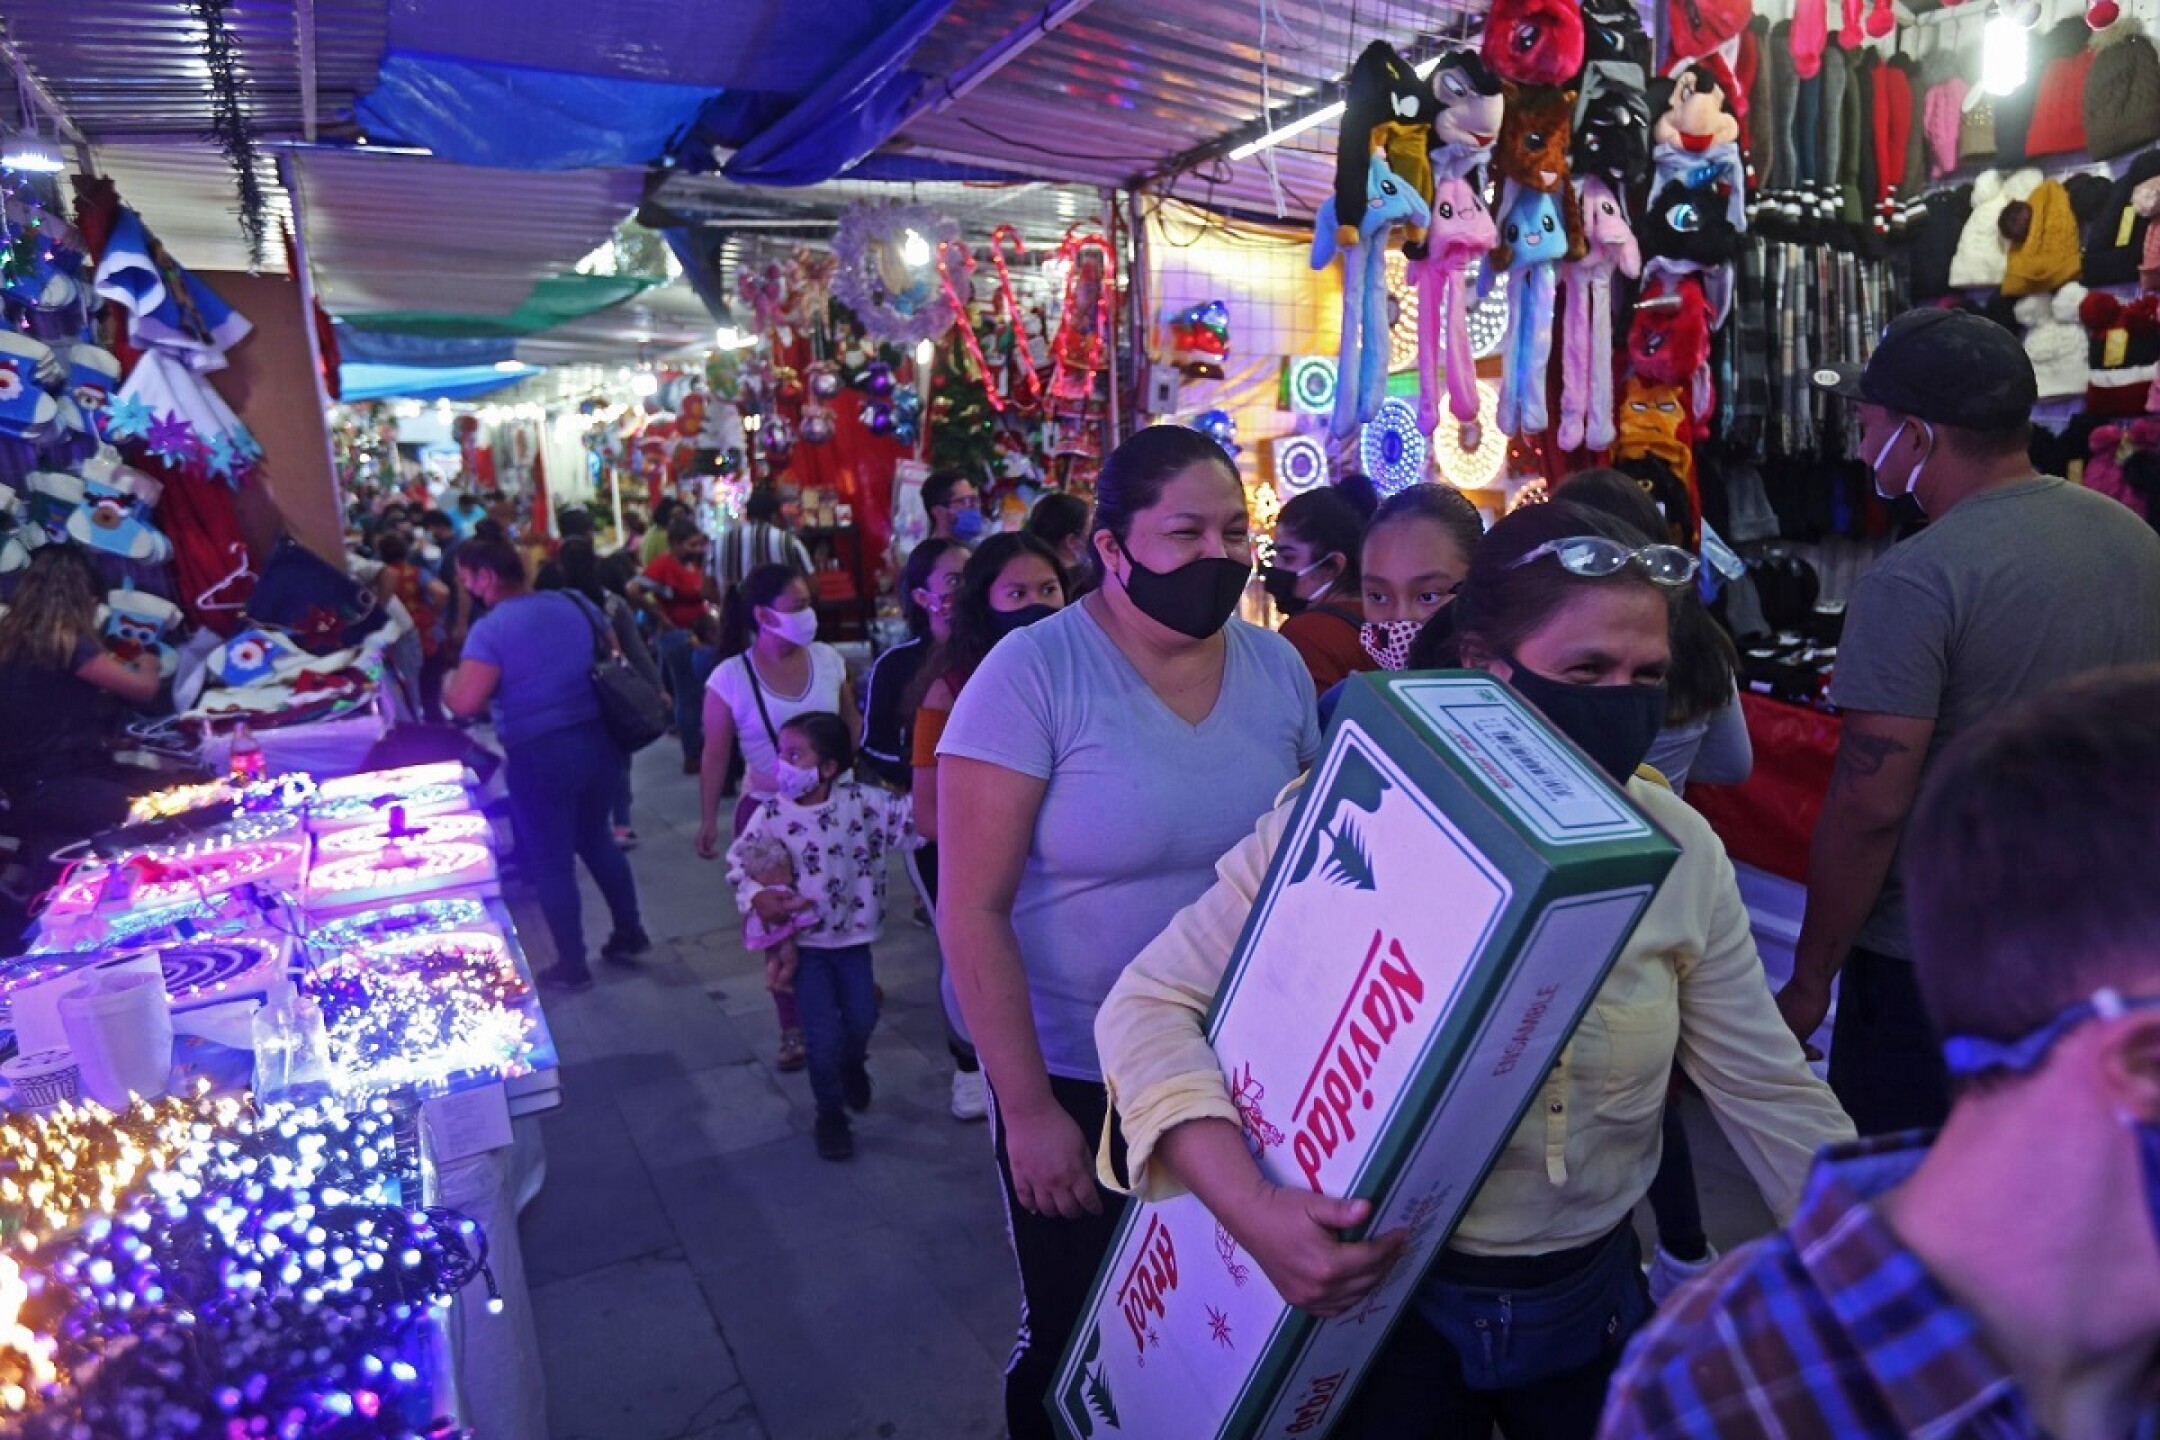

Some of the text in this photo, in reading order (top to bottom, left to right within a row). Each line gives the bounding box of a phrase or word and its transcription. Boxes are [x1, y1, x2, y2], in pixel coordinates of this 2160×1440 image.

[1293, 938, 1425, 1195] Navidad
[1492, 983, 1560, 1076] ENSAMBLE
[1123, 1223, 1178, 1355] Arbol
